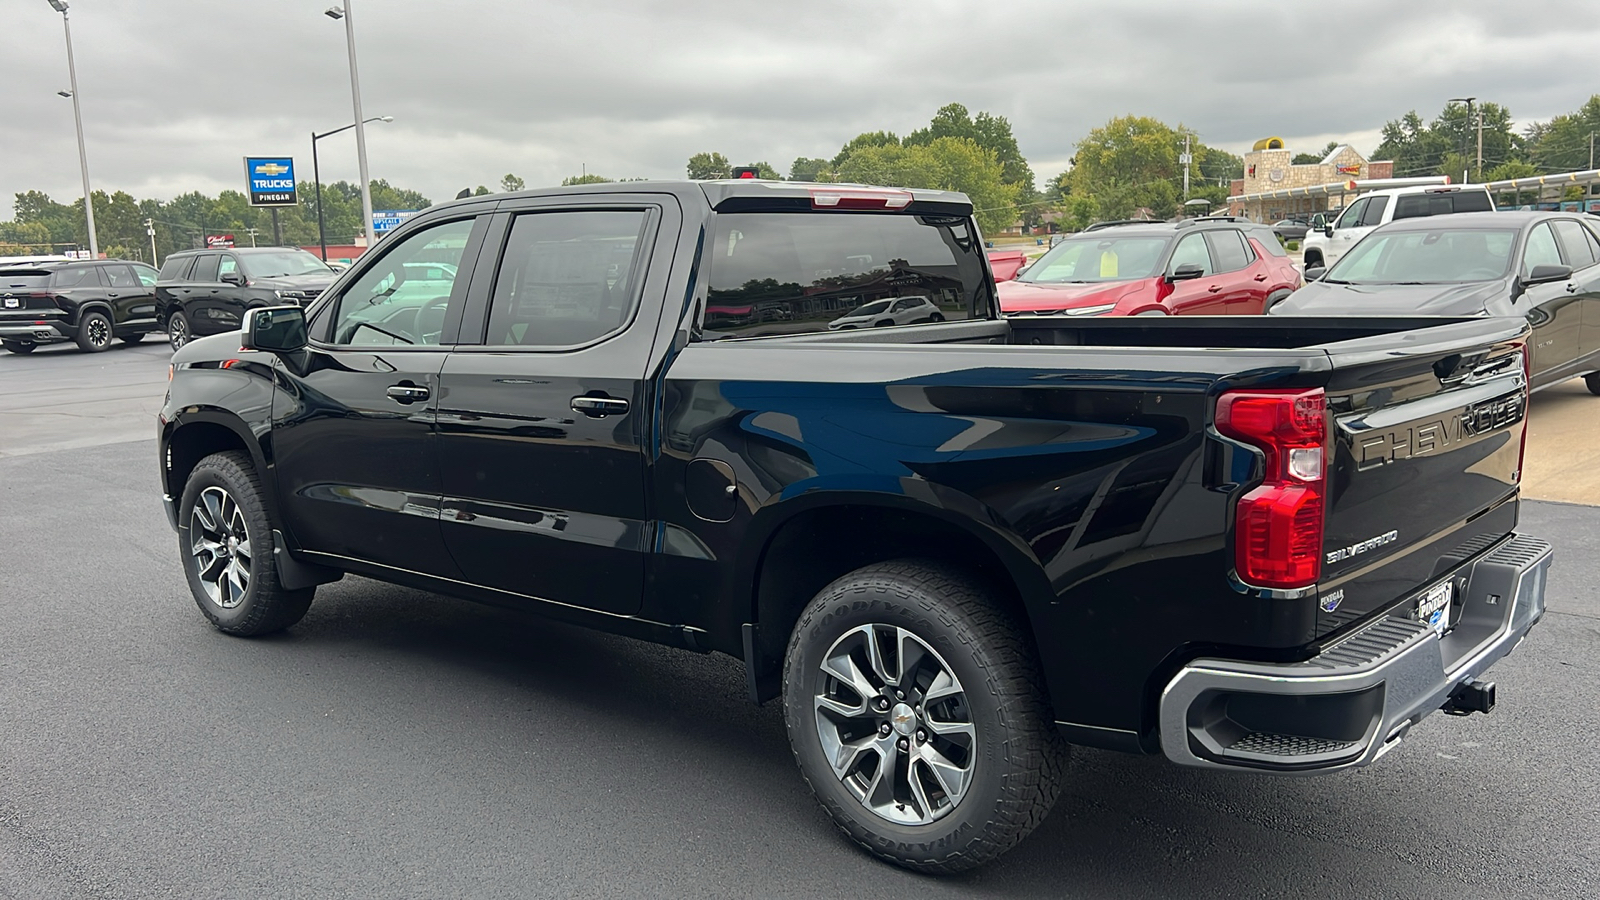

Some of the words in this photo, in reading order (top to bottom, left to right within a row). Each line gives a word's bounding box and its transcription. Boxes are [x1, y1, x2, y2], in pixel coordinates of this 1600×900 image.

[253, 180, 293, 188] TRUCKS
[1358, 392, 1527, 472] CHEVROLET
[1326, 529, 1398, 565] SILVERADO
[1320, 589, 1344, 606] PINEGAR
[809, 599, 957, 650] GOODYEAR
